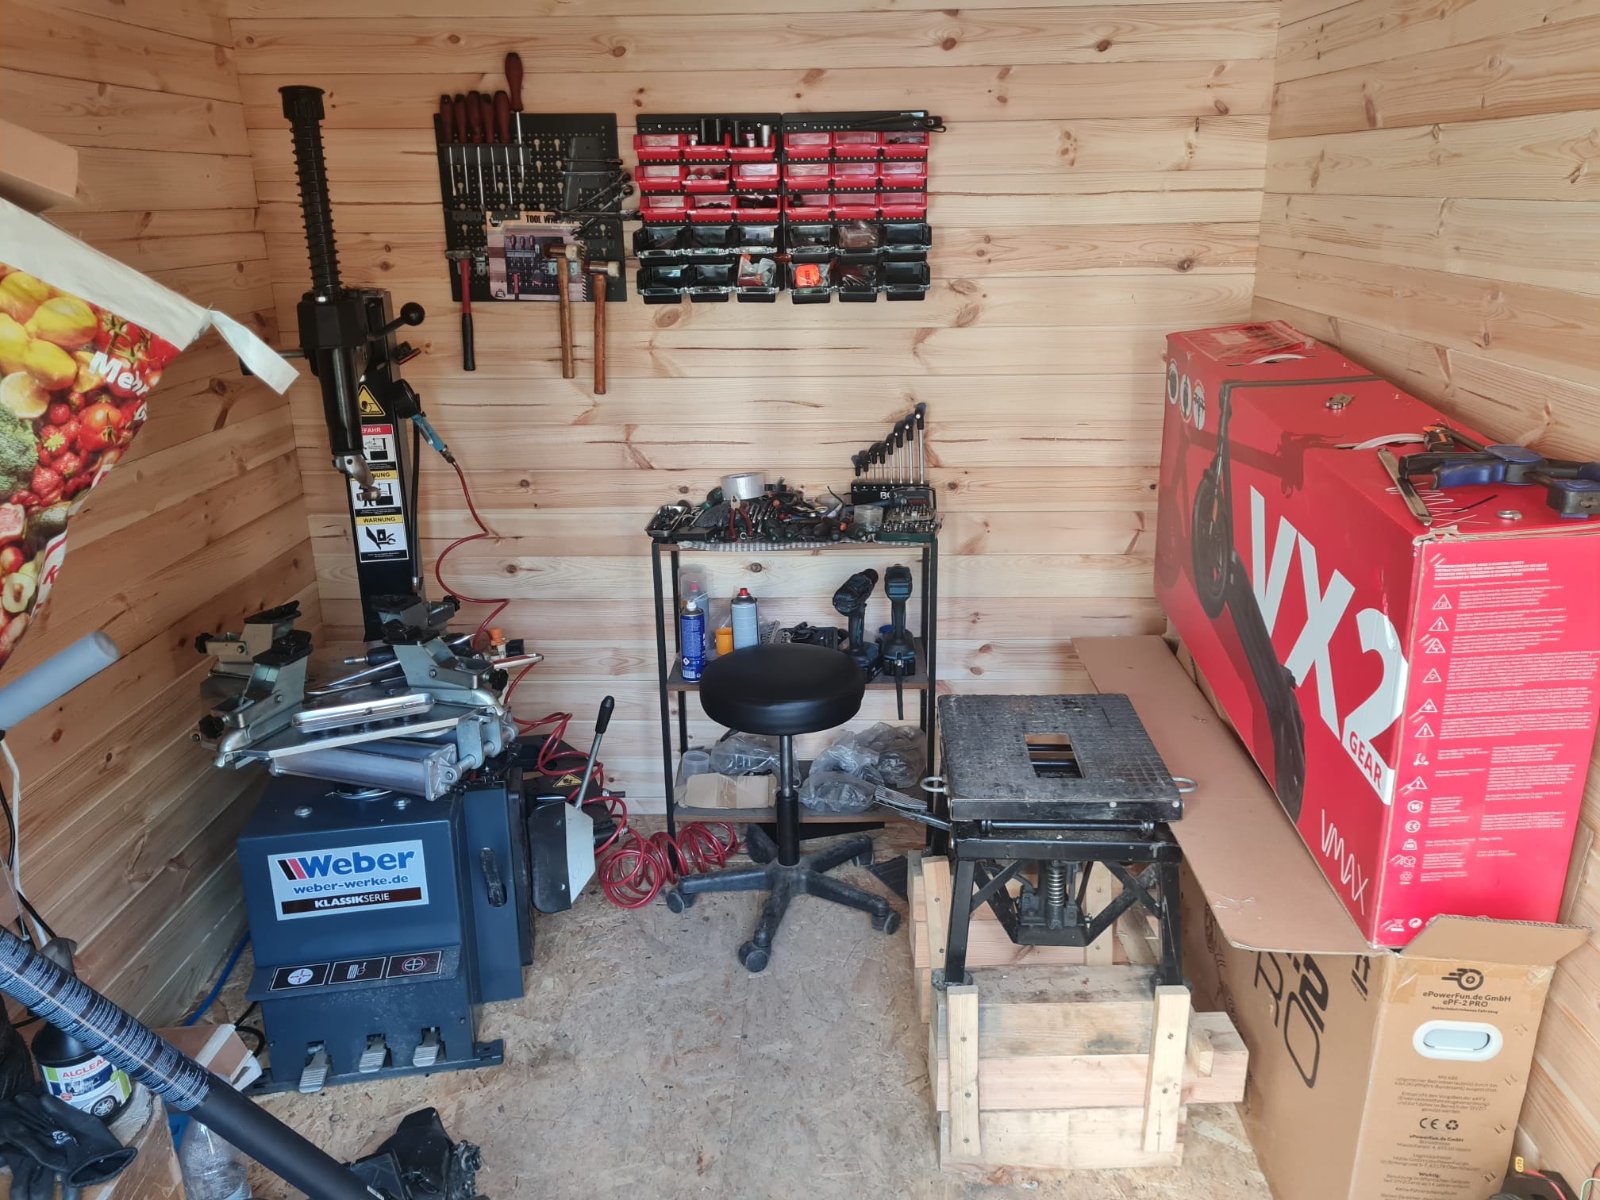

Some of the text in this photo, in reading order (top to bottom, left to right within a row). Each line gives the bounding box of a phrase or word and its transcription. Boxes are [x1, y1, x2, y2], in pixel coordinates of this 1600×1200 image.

[89, 351, 150, 396] Mehr
[1348, 730, 1383, 790] GEAR
[298, 851, 415, 879] Weber
[293, 874, 409, 895] weber-werke.de
[314, 893, 390, 909] KLASSIKSERIE
[1484, 994, 1511, 1002] GmbH
[62, 1058, 106, 1078] ALCLEA
